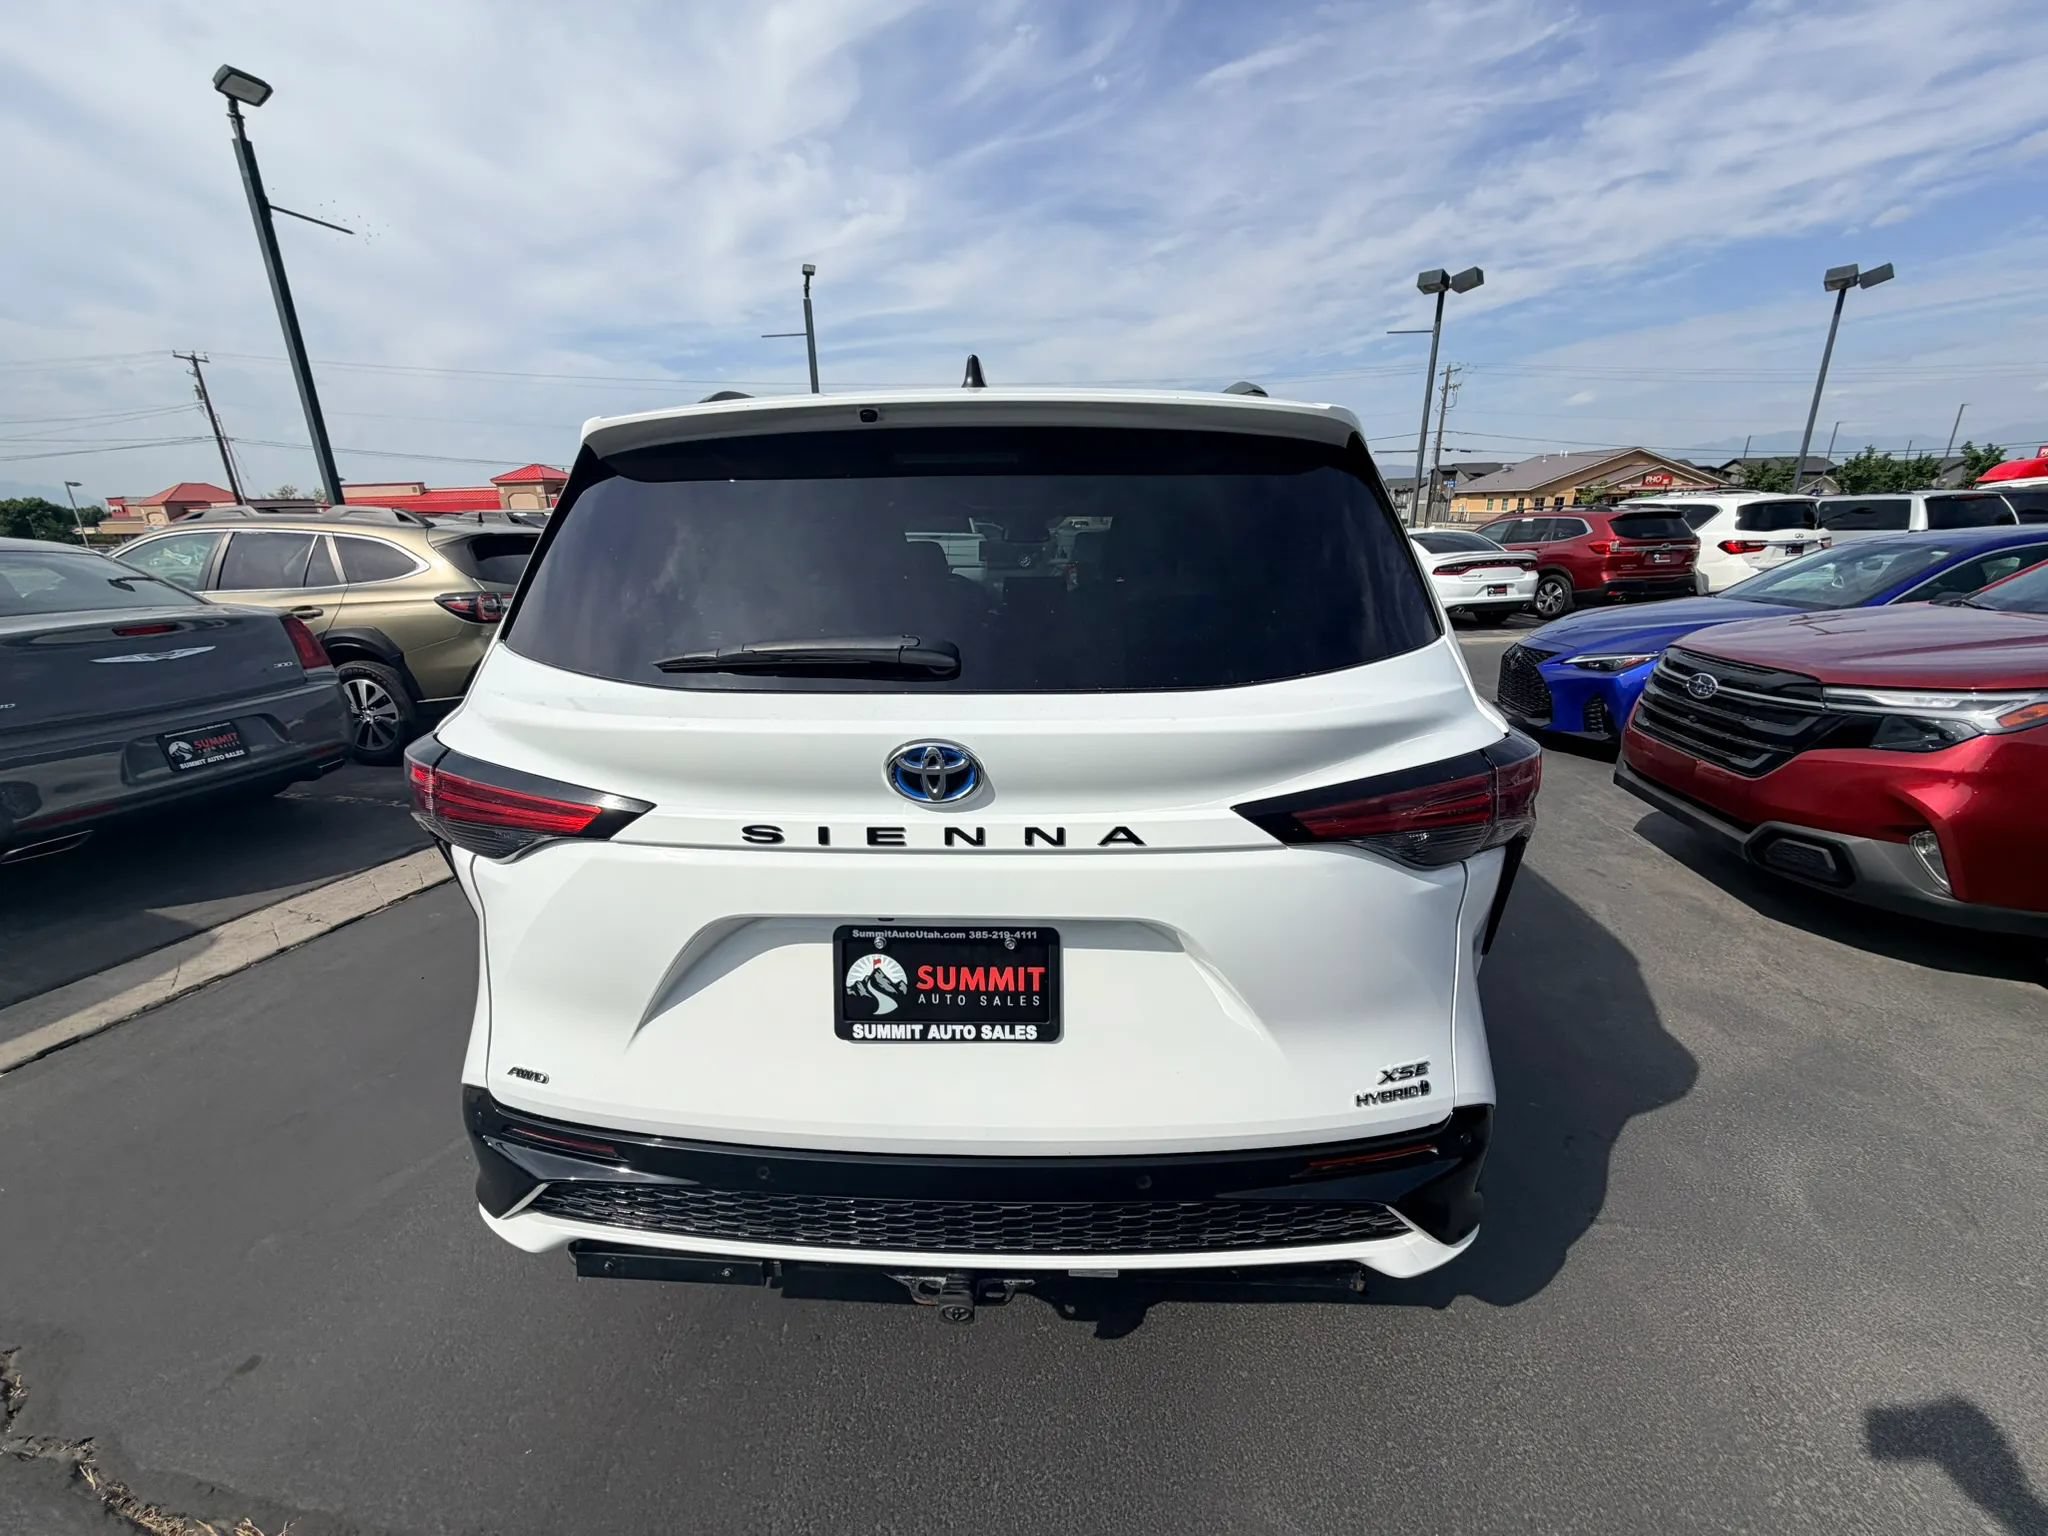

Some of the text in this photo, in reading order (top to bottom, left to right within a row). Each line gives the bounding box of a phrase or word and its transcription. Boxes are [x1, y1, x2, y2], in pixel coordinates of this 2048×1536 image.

[193, 732, 237, 749] SUMMIT
[180, 759, 206, 769] SUMMIT
[207, 754, 225, 763] AUTO
[741, 824, 1147, 847] SIENNA
[852, 929, 1038, 940] SummitAutoUtah.com 385-219-4111
[915, 965, 1046, 992] SUMMIT
[918, 993, 1040, 1006] AUTO SALES
[852, 1023, 1038, 1040] SUMMIT AUTO SALES
[507, 1066, 549, 1085] AWD
[1377, 1061, 1431, 1085] XSE
[1355, 1085, 1419, 1107] HYBRID
